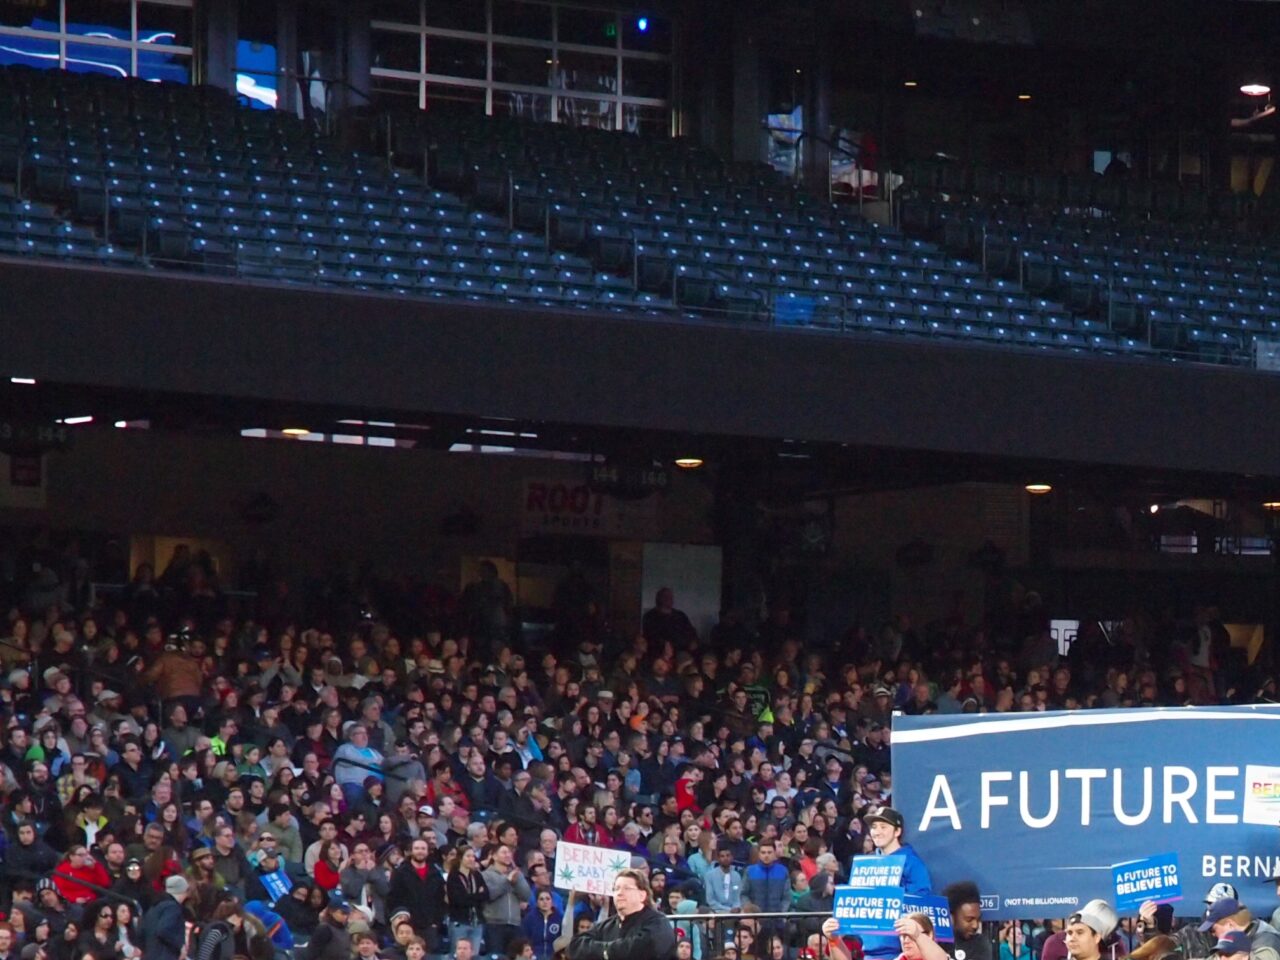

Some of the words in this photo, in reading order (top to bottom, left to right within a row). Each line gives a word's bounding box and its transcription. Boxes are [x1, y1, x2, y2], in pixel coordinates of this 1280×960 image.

[918, 775, 962, 831] A
[980, 766, 1240, 829] FUTURE
[563, 847, 603, 864] BERN
[577, 865, 608, 879] BABY
[859, 866, 889, 875] FUTURE
[890, 866, 901, 874] TO
[1117, 874, 1123, 883] A
[1124, 867, 1160, 881] FUTURE
[1162, 864, 1176, 874] TO
[850, 876, 887, 886] BELIEVE
[888, 876, 899, 886] IN
[1117, 877, 1162, 895] BELIEVE
[1164, 874, 1178, 886] IN
[837, 898, 844, 906] A
[845, 897, 883, 907] FUTURE
[886, 898, 900, 908] TO
[1022, 898, 1034, 906] THE
[1035, 896, 1079, 906] BILLIONAIRES)
[835, 908, 884, 919] BELIEVE
[885, 909, 900, 920] IN
[935, 908, 947, 916] TO
[938, 918, 950, 928] IN
